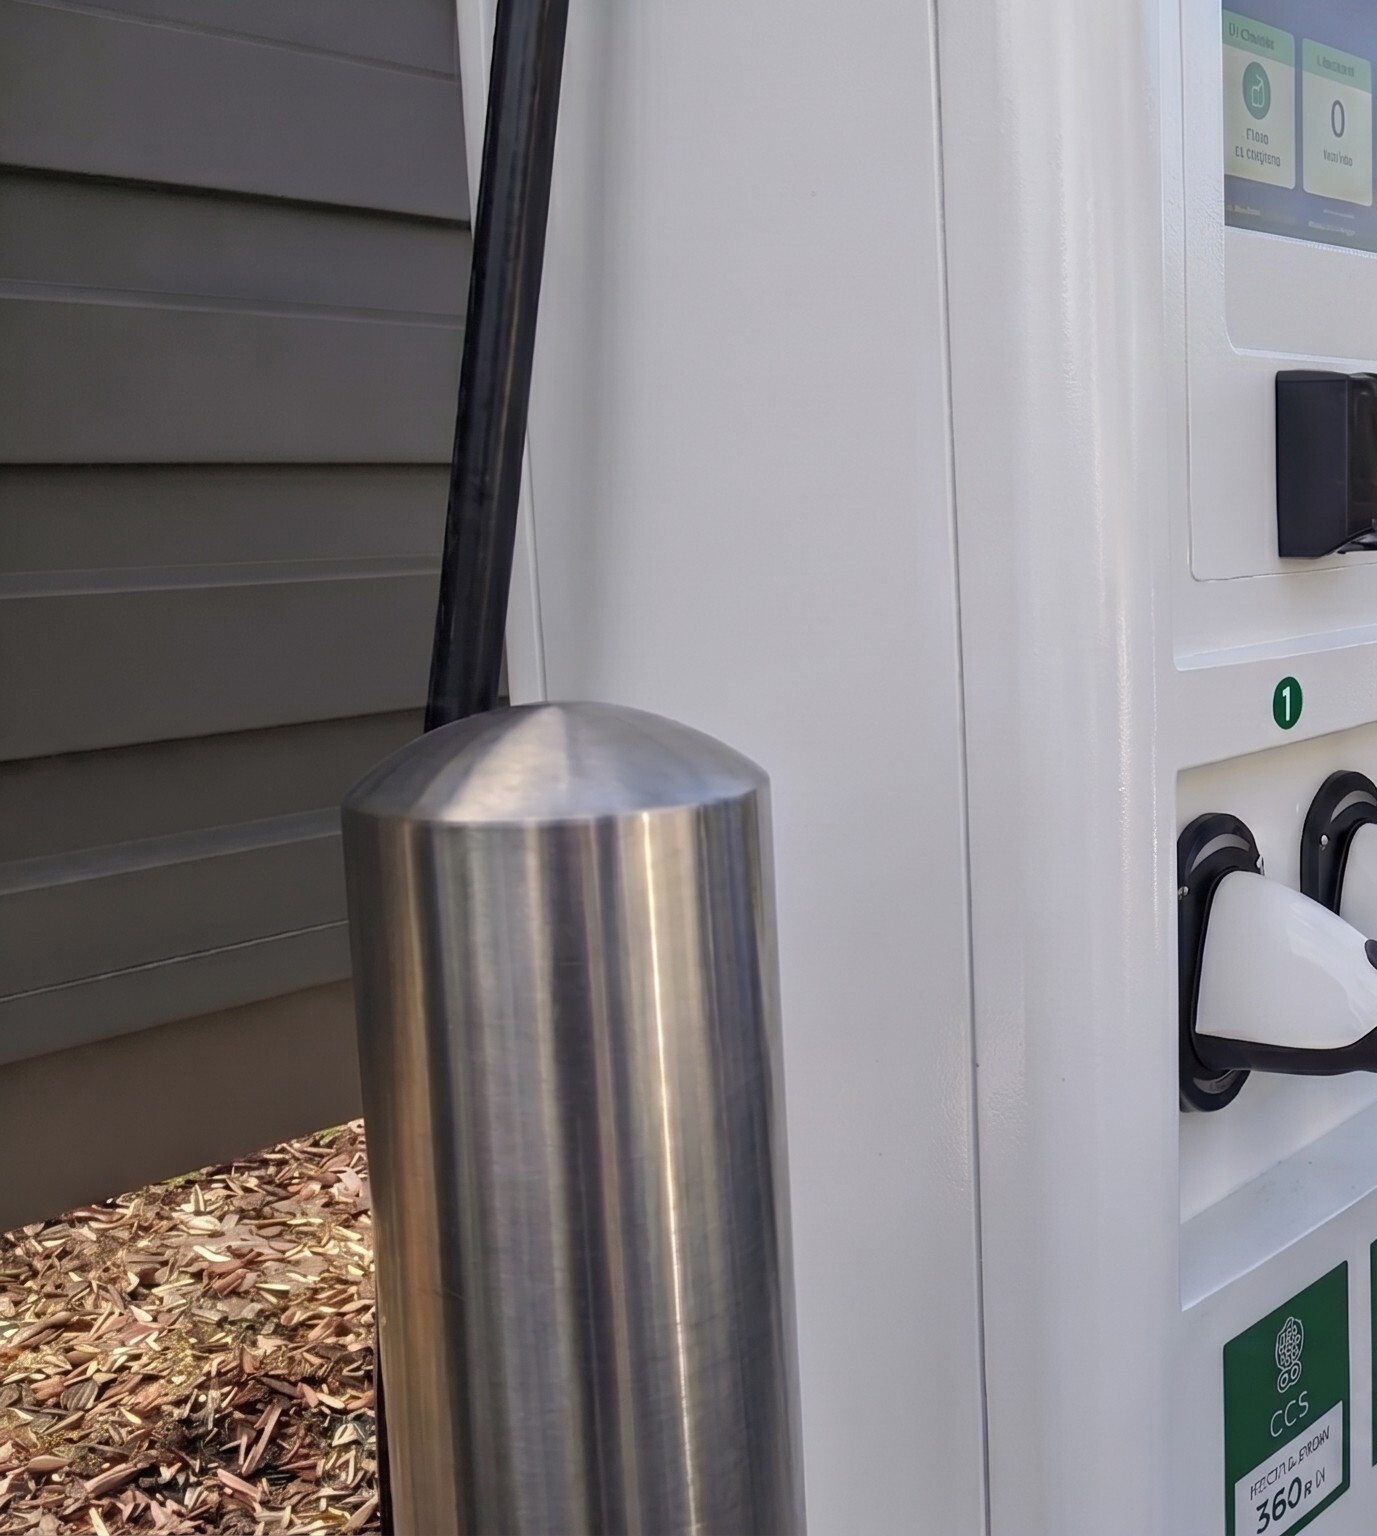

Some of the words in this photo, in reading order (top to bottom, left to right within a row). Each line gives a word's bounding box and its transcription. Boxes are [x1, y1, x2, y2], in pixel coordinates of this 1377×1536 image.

[1282, 685, 1292, 722] 1
[1269, 1389, 1309, 1438] CCS
[1255, 1476, 1303, 1535] 360
